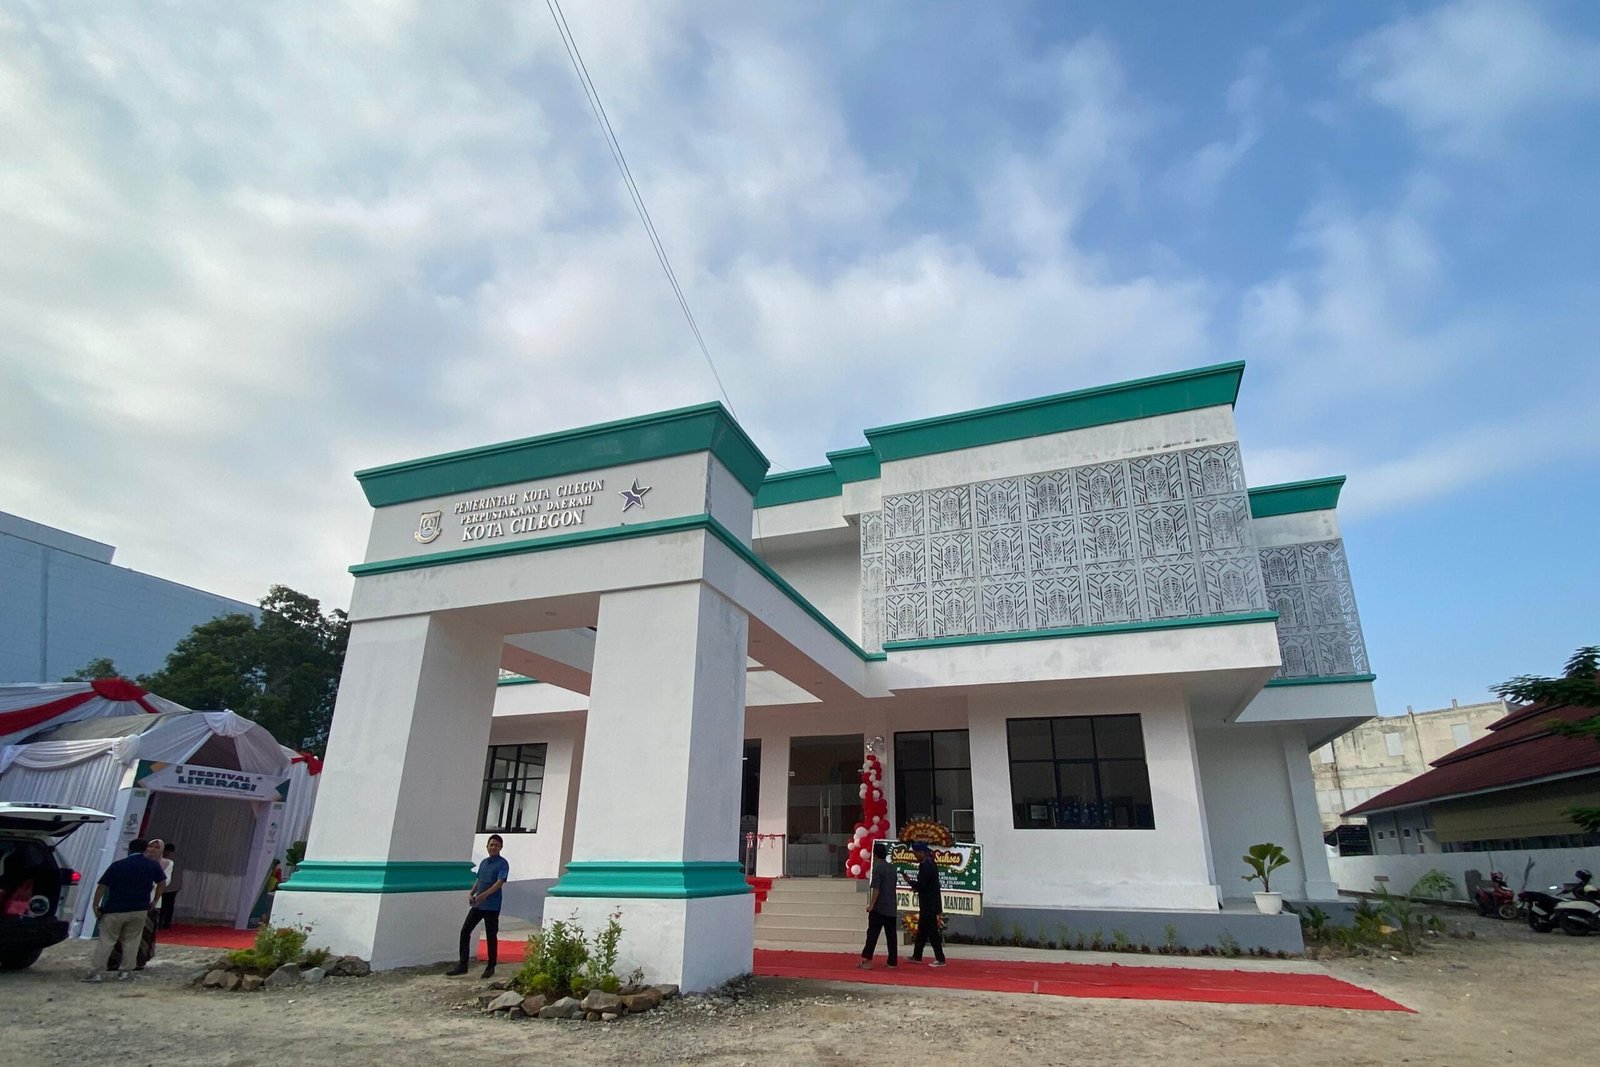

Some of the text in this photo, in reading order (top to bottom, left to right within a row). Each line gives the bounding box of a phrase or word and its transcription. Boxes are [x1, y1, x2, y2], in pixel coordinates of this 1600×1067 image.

[454, 480, 604, 514] PEMERINTAH KOTA CILEGON
[460, 495, 593, 525] PERPUSTAKAAN DAERAH
[462, 509, 585, 542] KOTA CILEGON
[178, 776, 257, 792] LITERASI
[188, 769, 250, 783] FESTIVAL
[892, 848, 961, 863] Selam Sukses
[943, 895, 974, 911] MANDIRI
